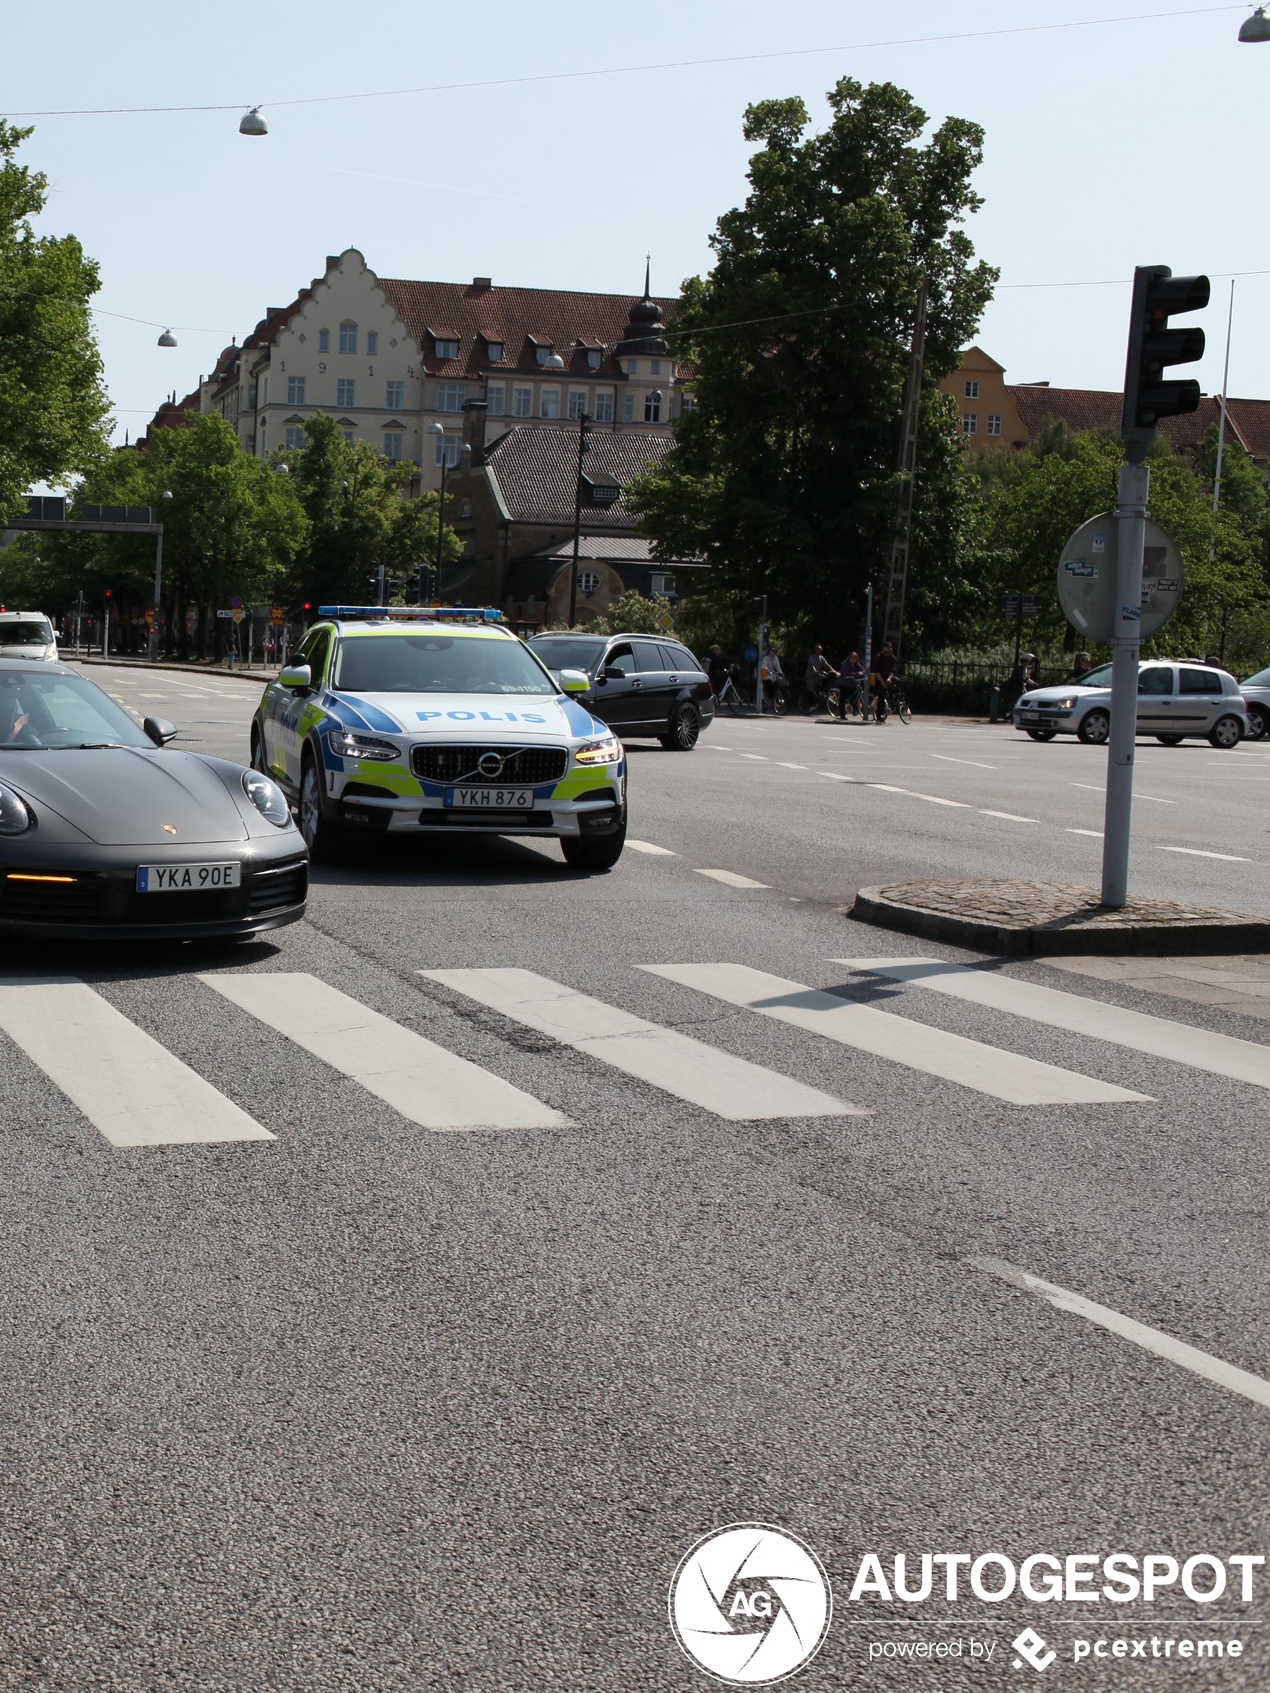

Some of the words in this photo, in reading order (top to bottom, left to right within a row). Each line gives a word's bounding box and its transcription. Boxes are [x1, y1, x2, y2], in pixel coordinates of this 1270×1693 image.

[414, 711, 547, 724] POLIS
[459, 790, 490, 805] YKH
[495, 791, 527, 806] 876
[155, 868, 192, 888] YKA
[198, 866, 233, 886] 90E
